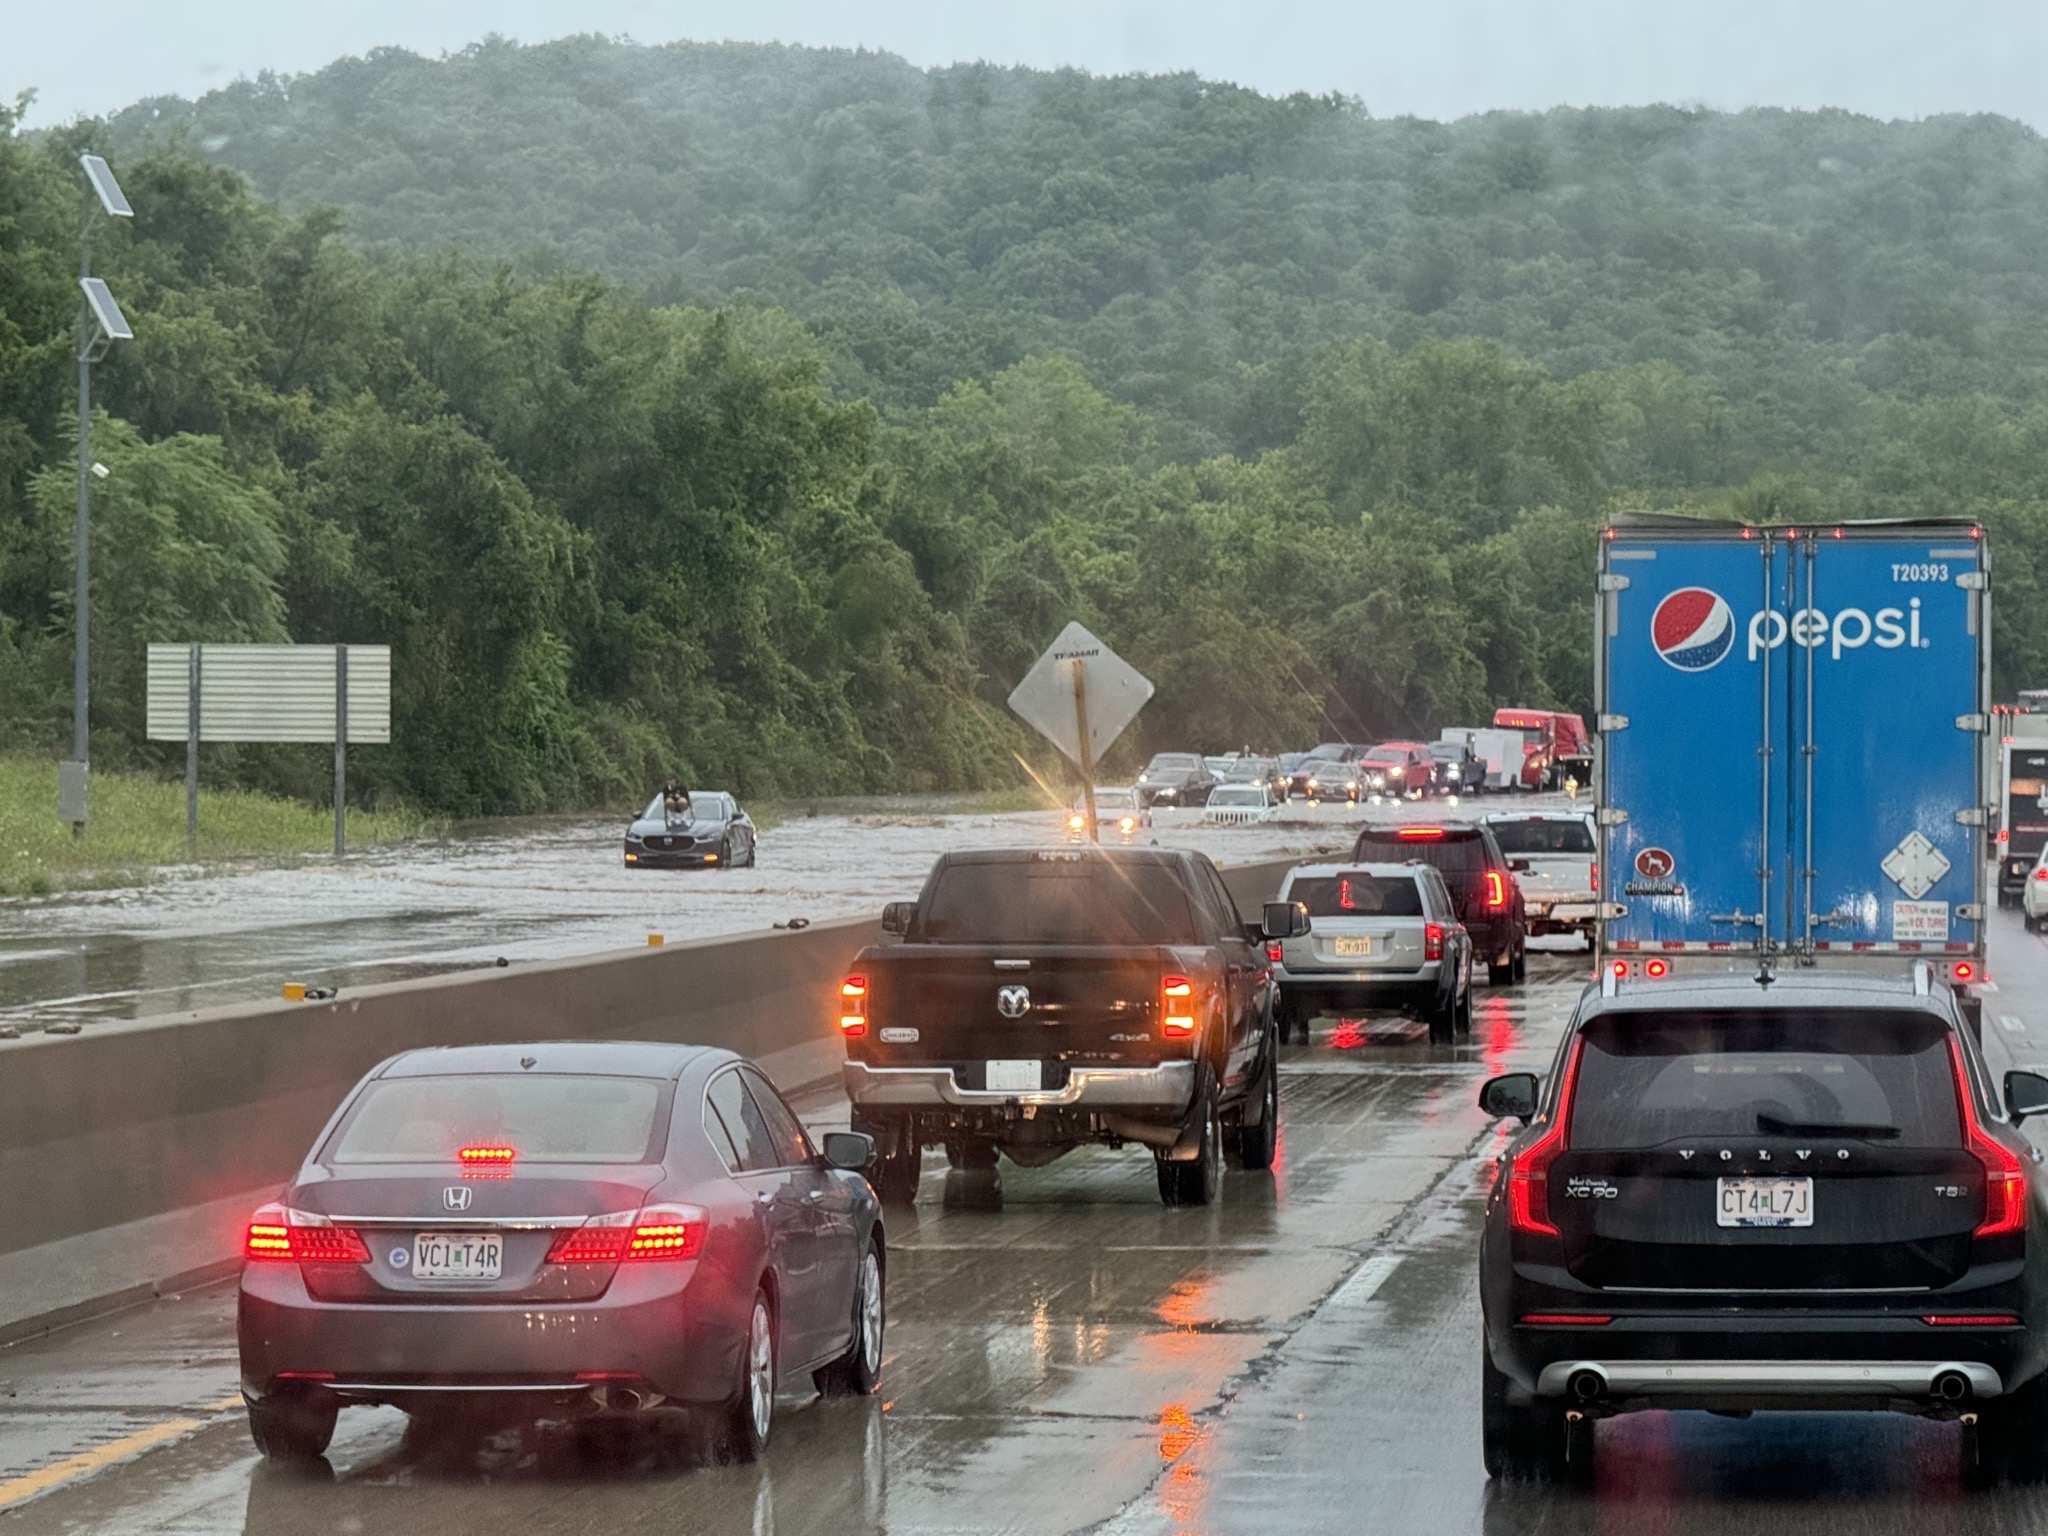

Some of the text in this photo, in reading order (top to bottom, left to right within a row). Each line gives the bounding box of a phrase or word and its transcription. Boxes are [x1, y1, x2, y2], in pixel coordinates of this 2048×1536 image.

[1891, 564, 1949, 582] T20393
[1748, 597, 1921, 661] pepsi
[1625, 881, 1674, 892] CHAMPION
[1679, 1149, 1850, 1161] VOLVO
